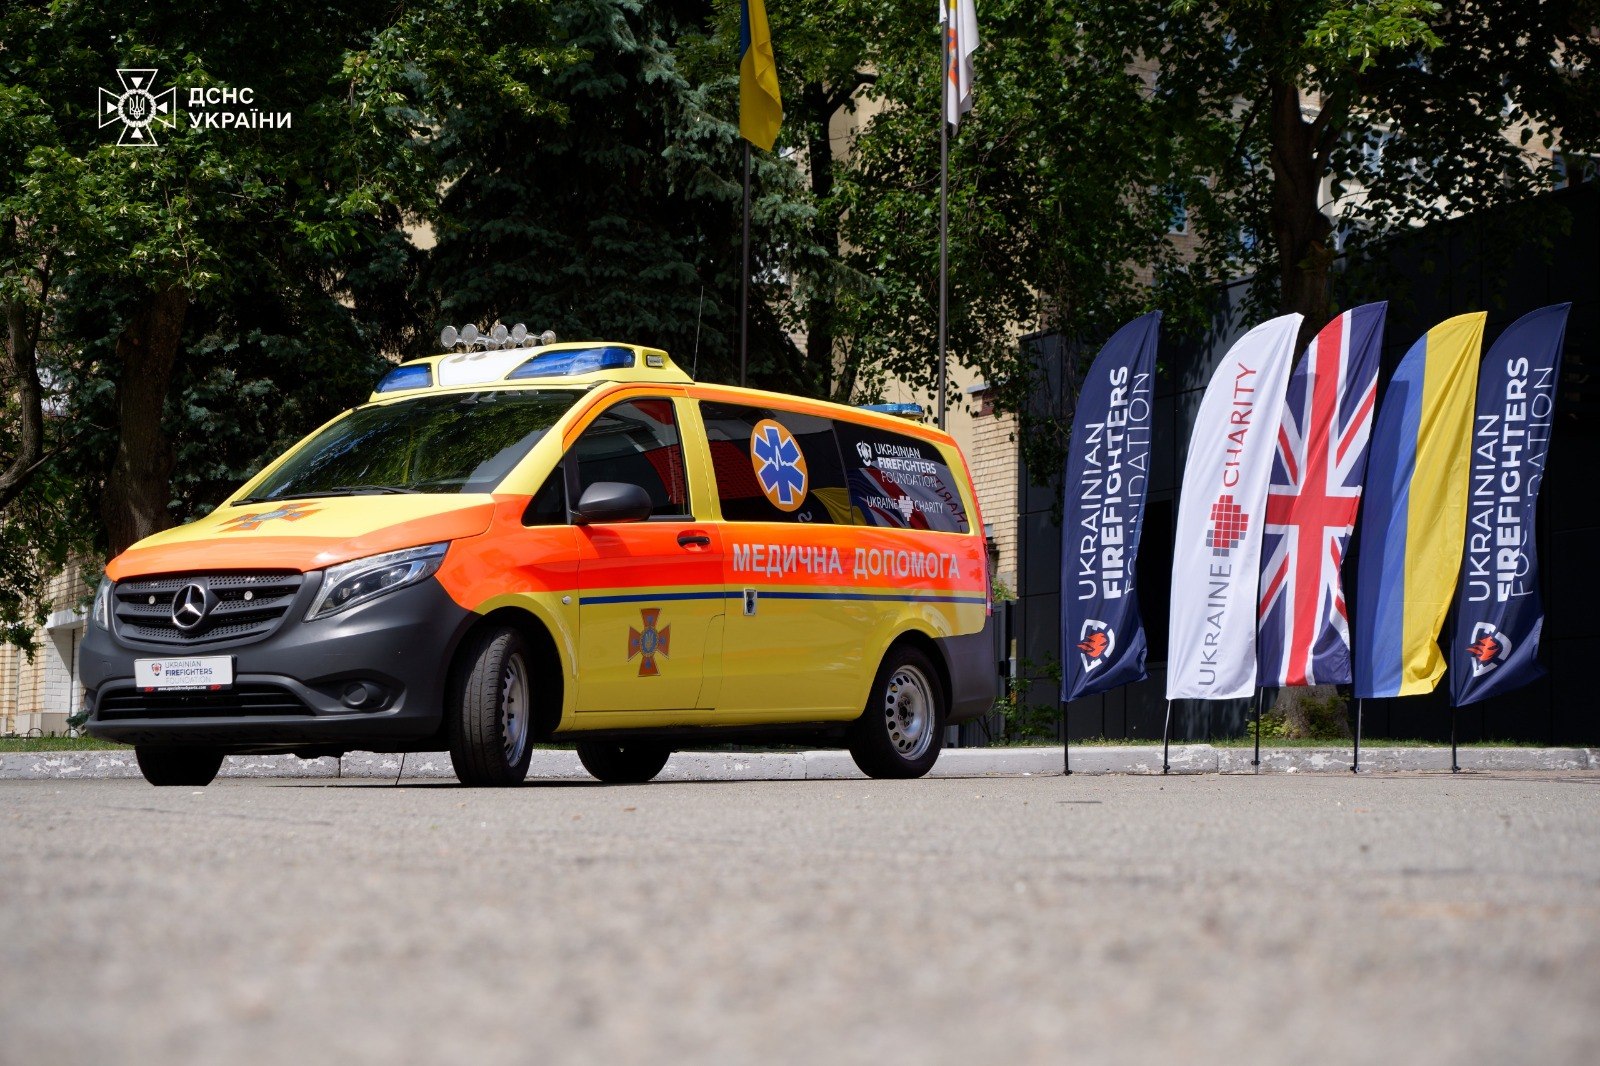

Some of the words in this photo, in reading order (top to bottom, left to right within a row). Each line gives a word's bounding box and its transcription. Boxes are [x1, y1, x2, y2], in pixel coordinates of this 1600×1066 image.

[873, 442, 921, 459] UKRAINIAN
[877, 457, 937, 475] FIREFIGHTERS
[880, 470, 938, 488] FOUNDATION
[1100, 365, 1129, 600] FIREFIGHTERS
[1496, 356, 1529, 602] FIREFIGHTERS
[866, 495, 900, 510] UKRAINE
[914, 499, 943, 514] CHARITY
[1078, 422, 1105, 601] UKRAINIAN
[1468, 413, 1500, 602] UKRAINIAN
[1197, 563, 1232, 687] UKRAINE
[1222, 362, 1258, 488] CHARITY
[732, 543, 843, 578] МЕДИЧНА
[853, 547, 961, 580] ДОПОМОГА
[164, 660, 202, 669] UKRAINIAN
[165, 667, 213, 677] FIREFIGHTERS
[165, 675, 212, 685] FOUNDATION
